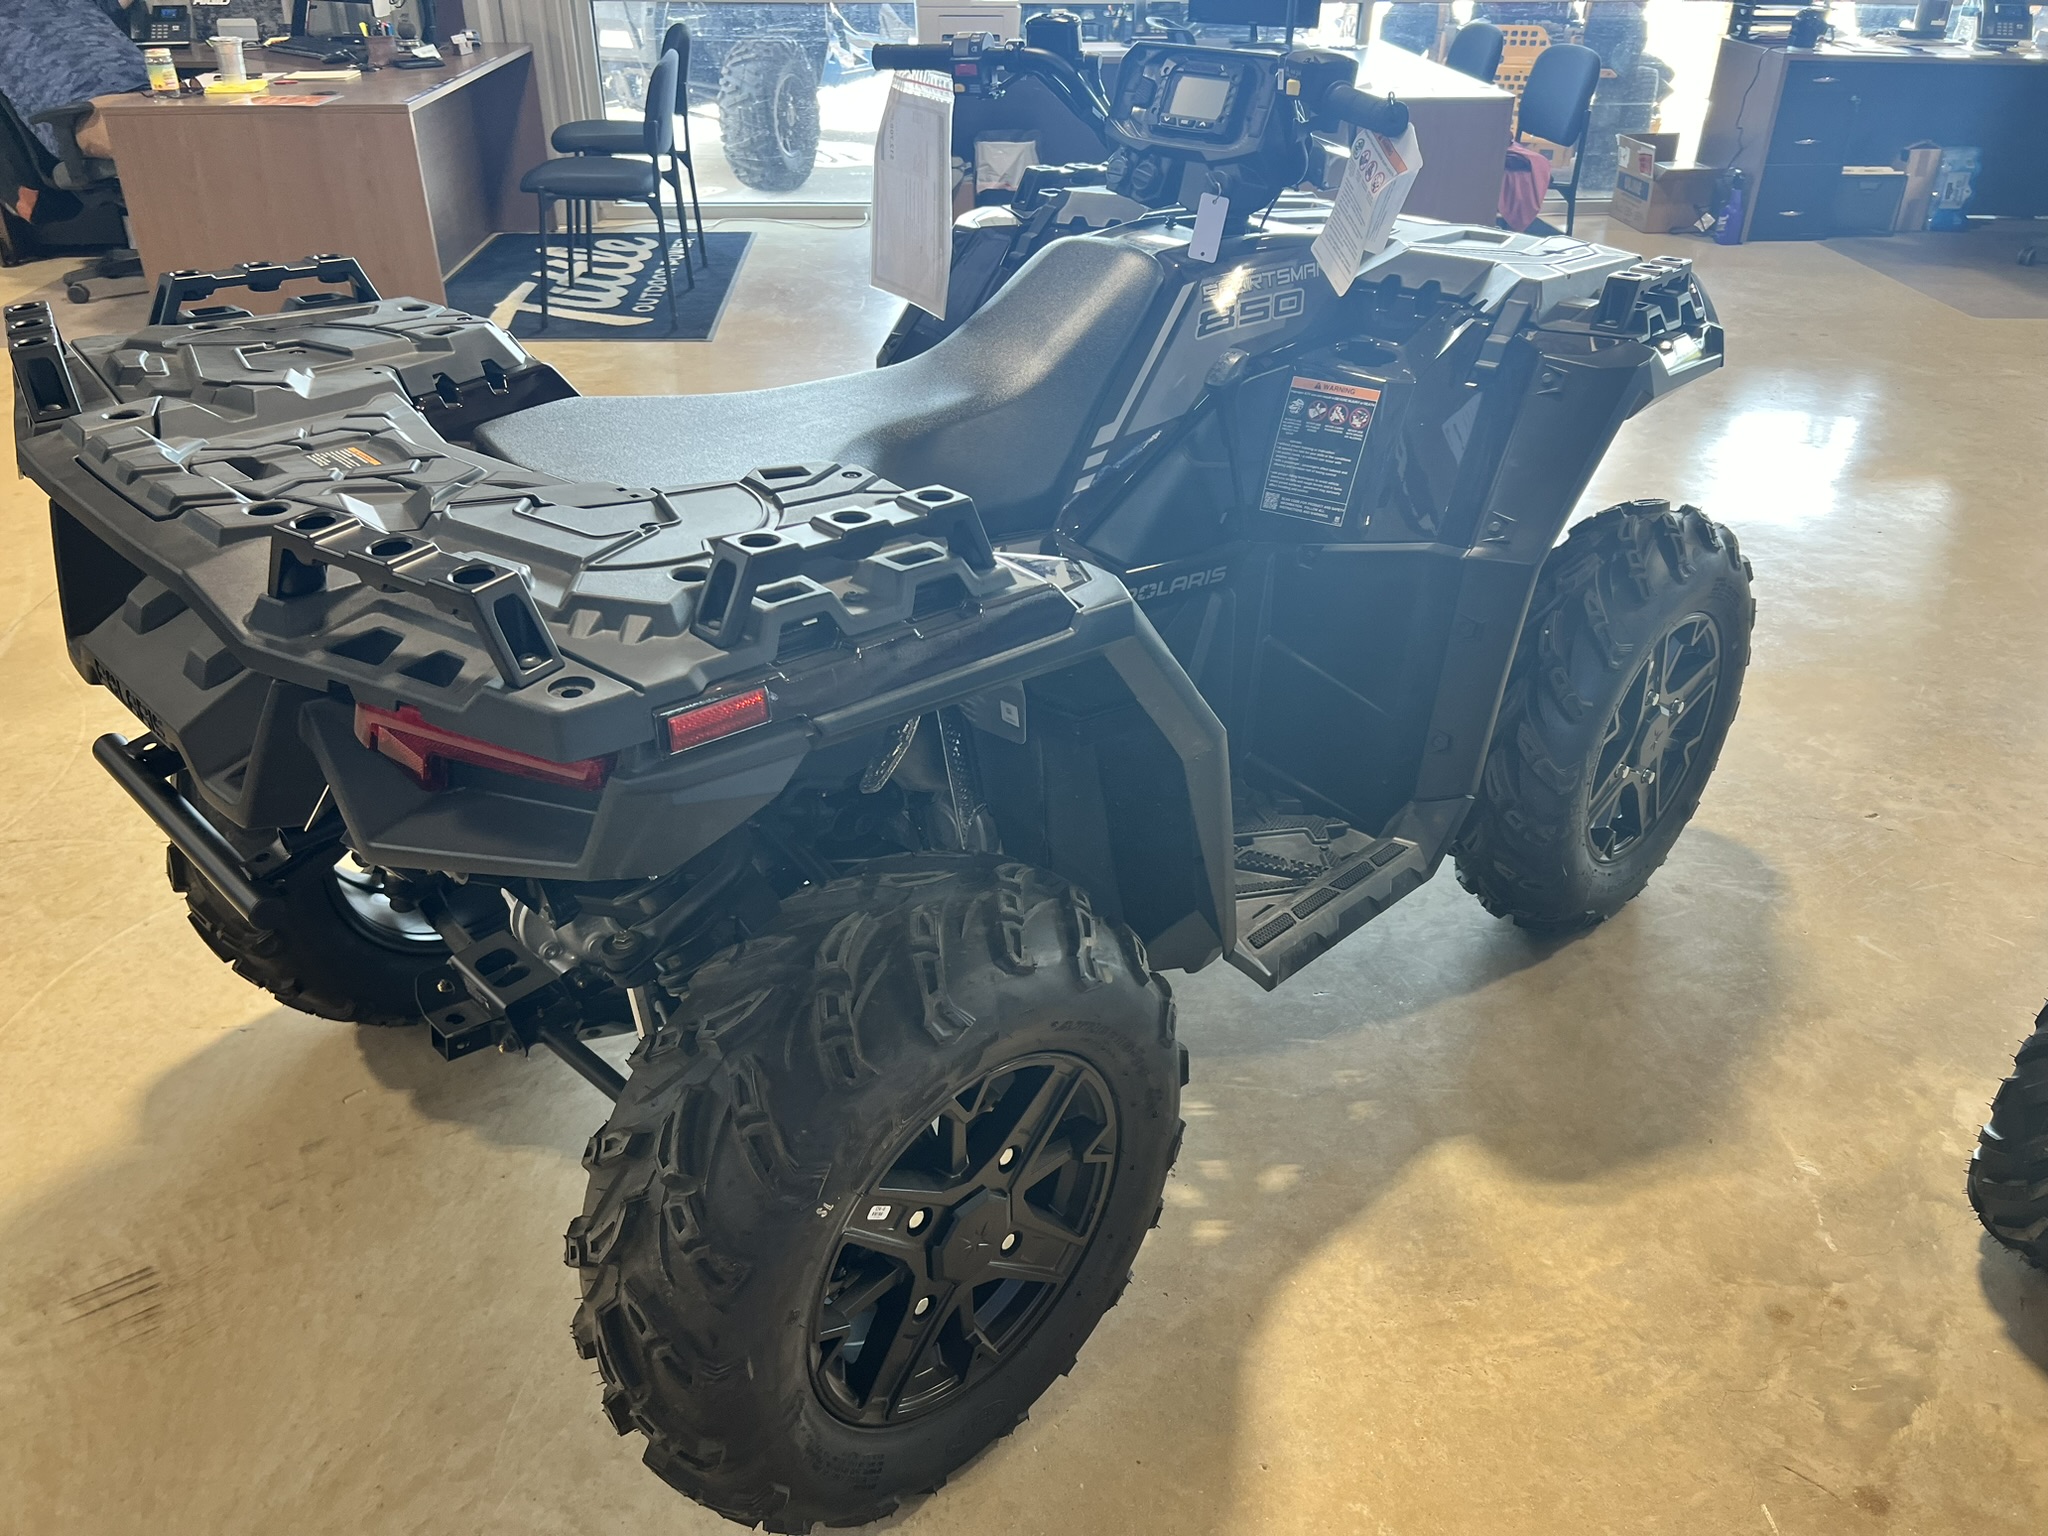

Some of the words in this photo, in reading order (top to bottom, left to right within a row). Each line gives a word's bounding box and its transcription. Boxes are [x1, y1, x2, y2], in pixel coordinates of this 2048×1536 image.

[1203, 262, 1320, 302] SRTSMA
[1195, 287, 1305, 340] 850
[1322, 383, 1357, 395] WARNING
